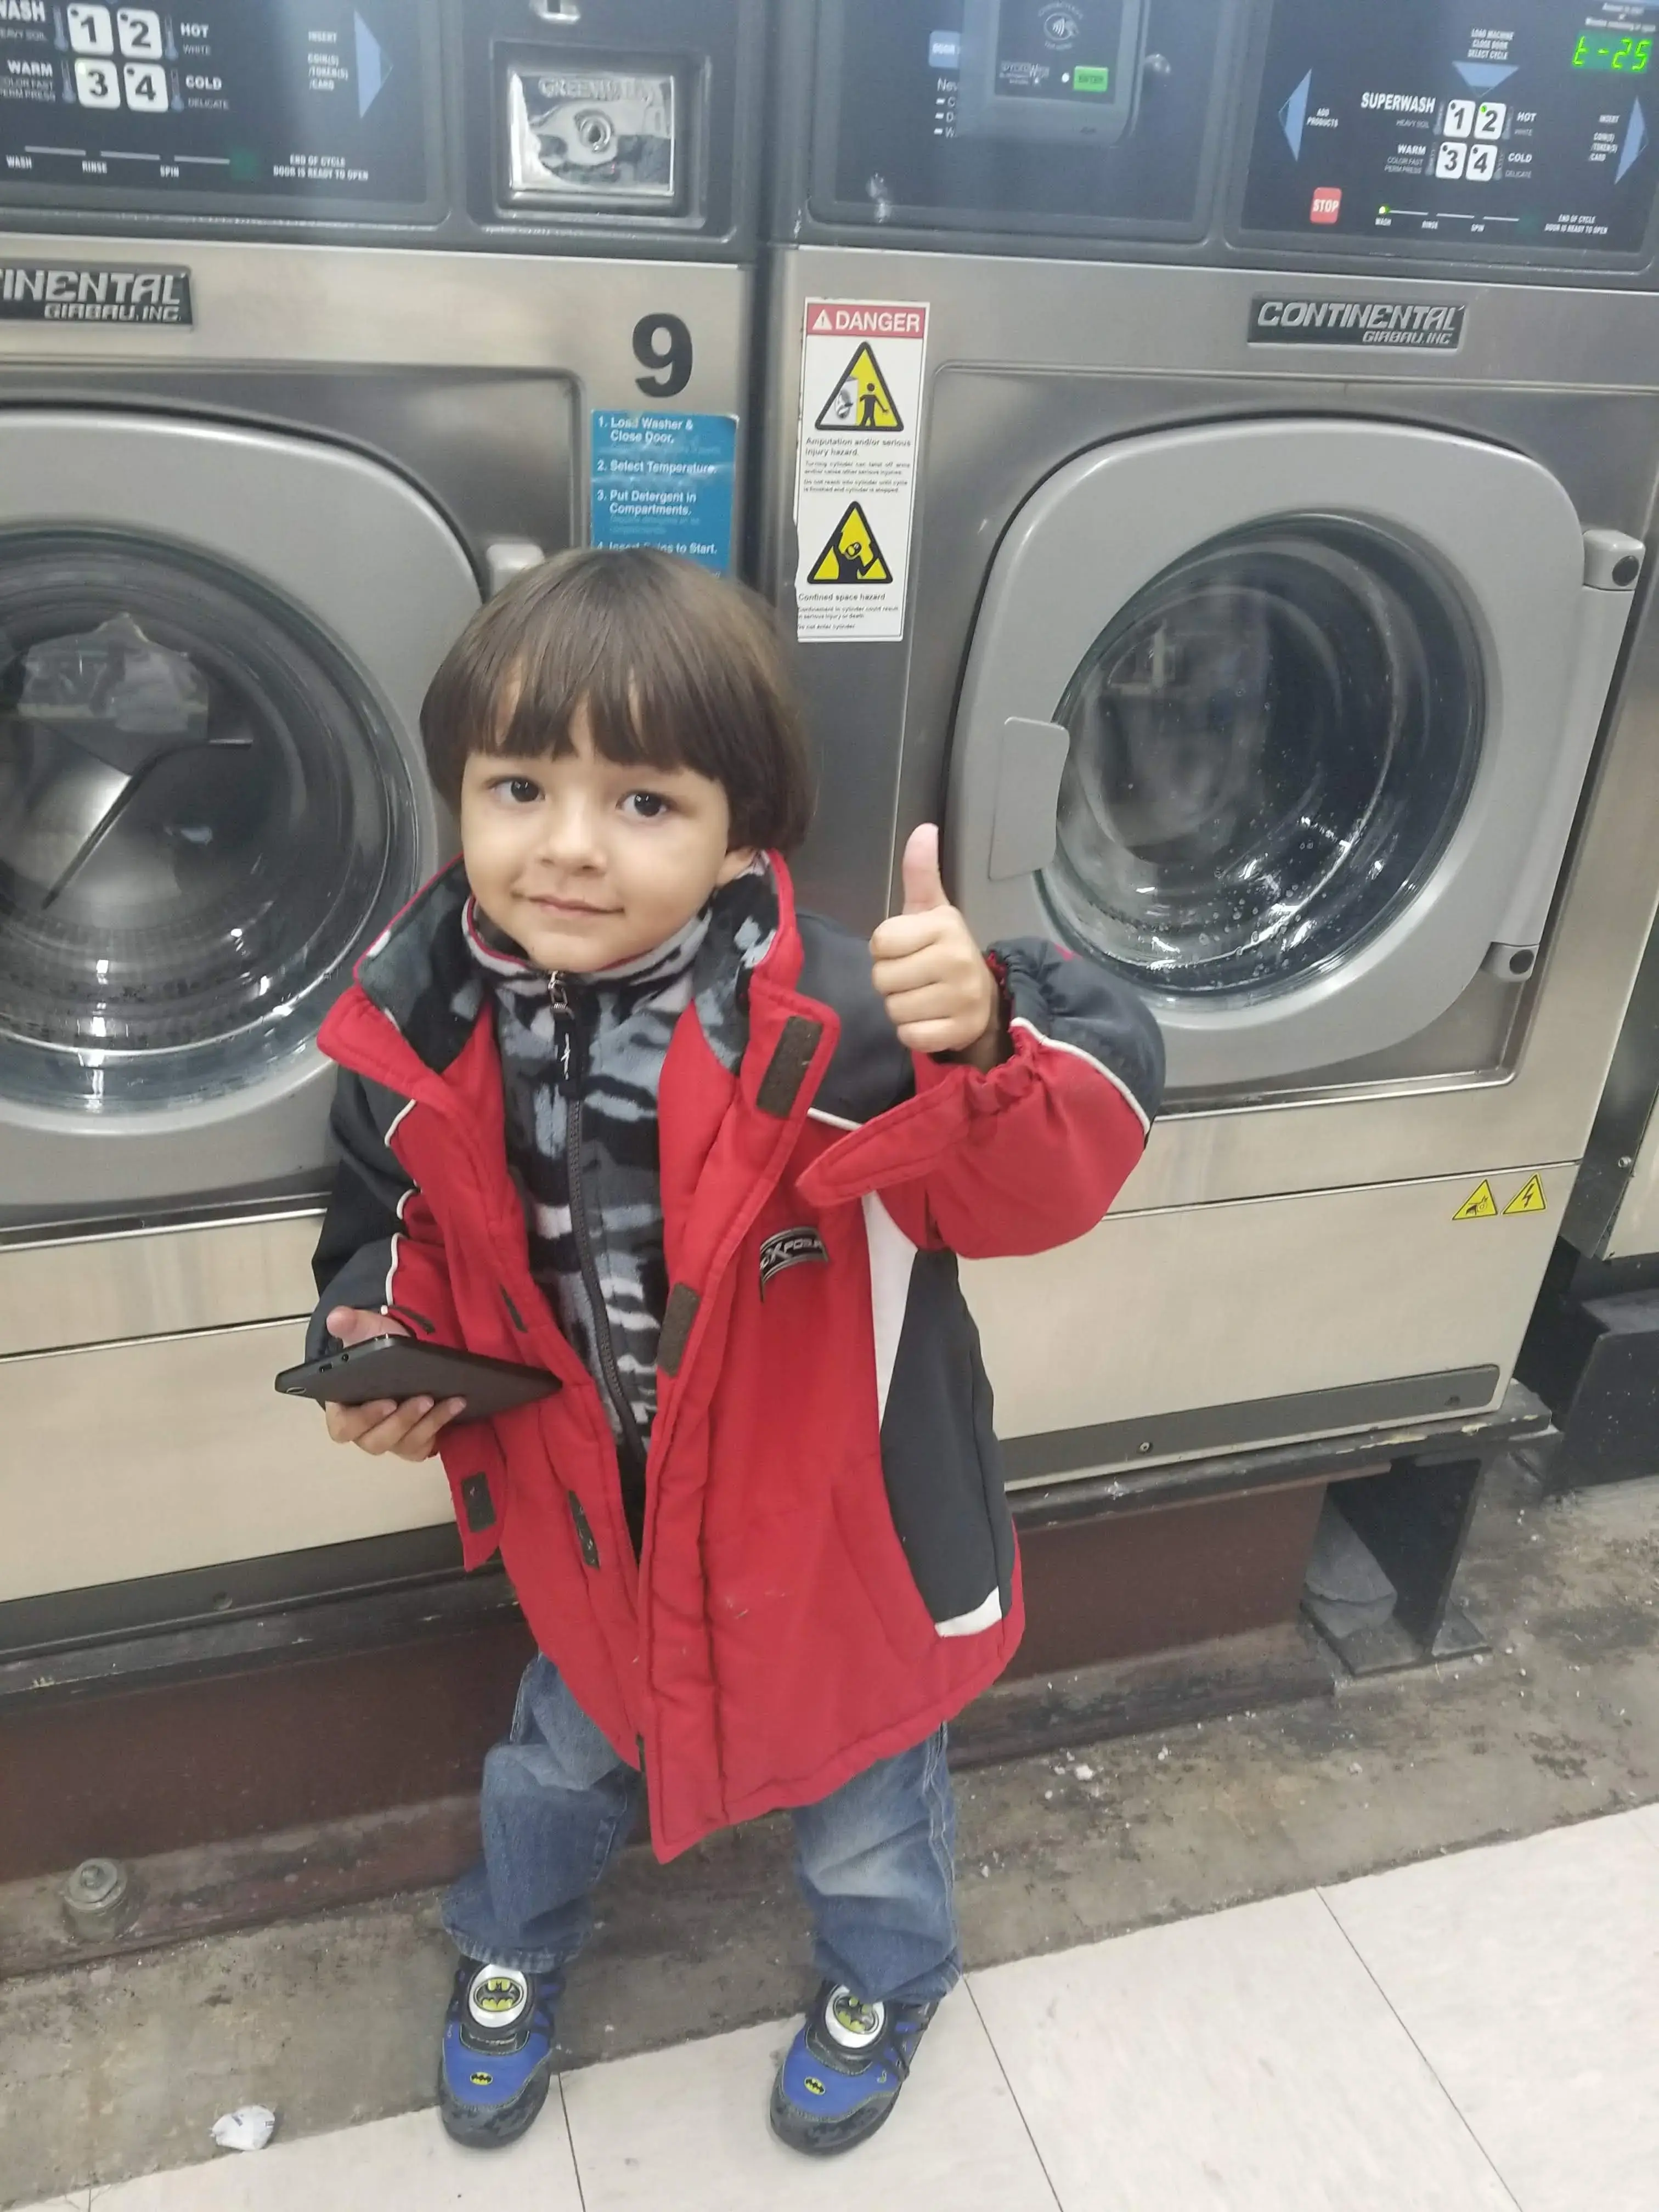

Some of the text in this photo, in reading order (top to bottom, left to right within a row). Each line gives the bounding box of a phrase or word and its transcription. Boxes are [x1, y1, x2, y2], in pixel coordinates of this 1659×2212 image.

[81, 15, 97, 43] 1
[129, 19, 151, 48] 2
[180, 22, 209, 38] HOT
[7, 59, 53, 76] WARM
[88, 70, 109, 97] 3
[135, 74, 156, 101] 4
[185, 75, 222, 91] COLD
[1361, 92, 1436, 114] SUPERWASH
[1307, 117, 1338, 128] PRODUCTS
[1454, 108, 1465, 130] 1
[1482, 110, 1498, 132] 2
[1516, 111, 1537, 122] HOT
[1397, 144, 1426, 156] WARM
[6, 155, 32, 169] WASH
[1444, 150, 1458, 172] 3
[1473, 152, 1488, 174] 4
[1508, 153, 1532, 163] COLD
[82, 160, 108, 173] RINSE
[160, 165, 179, 177] SPIN
[1505, 170, 1532, 179] DELICATE
[1313, 199, 1339, 213] STOP
[1471, 224, 1485, 232] SPIN
[0, 269, 185, 304] INENTAL
[836, 310, 920, 332] DANGER
[1257, 301, 1465, 331] CONTINENTAL
[633, 312, 693, 398] 9
[599, 416, 607, 428] 1.
[641, 417, 682, 430] Washer
[685, 419, 693, 431] &
[610, 430, 642, 442] Close
[806, 437, 853, 447] Amputation
[882, 439, 911, 447] serious
[597, 459, 718, 476] 2. Select Temperature.
[610, 489, 629, 501] Put
[631, 490, 684, 504] Detergent
[686, 491, 697, 503] in
[610, 503, 692, 517] Compartments.
[676, 542, 687, 555] to
[689, 542, 718, 555] Start.
[798, 593, 833, 601] Confined
[836, 594, 858, 602] space
